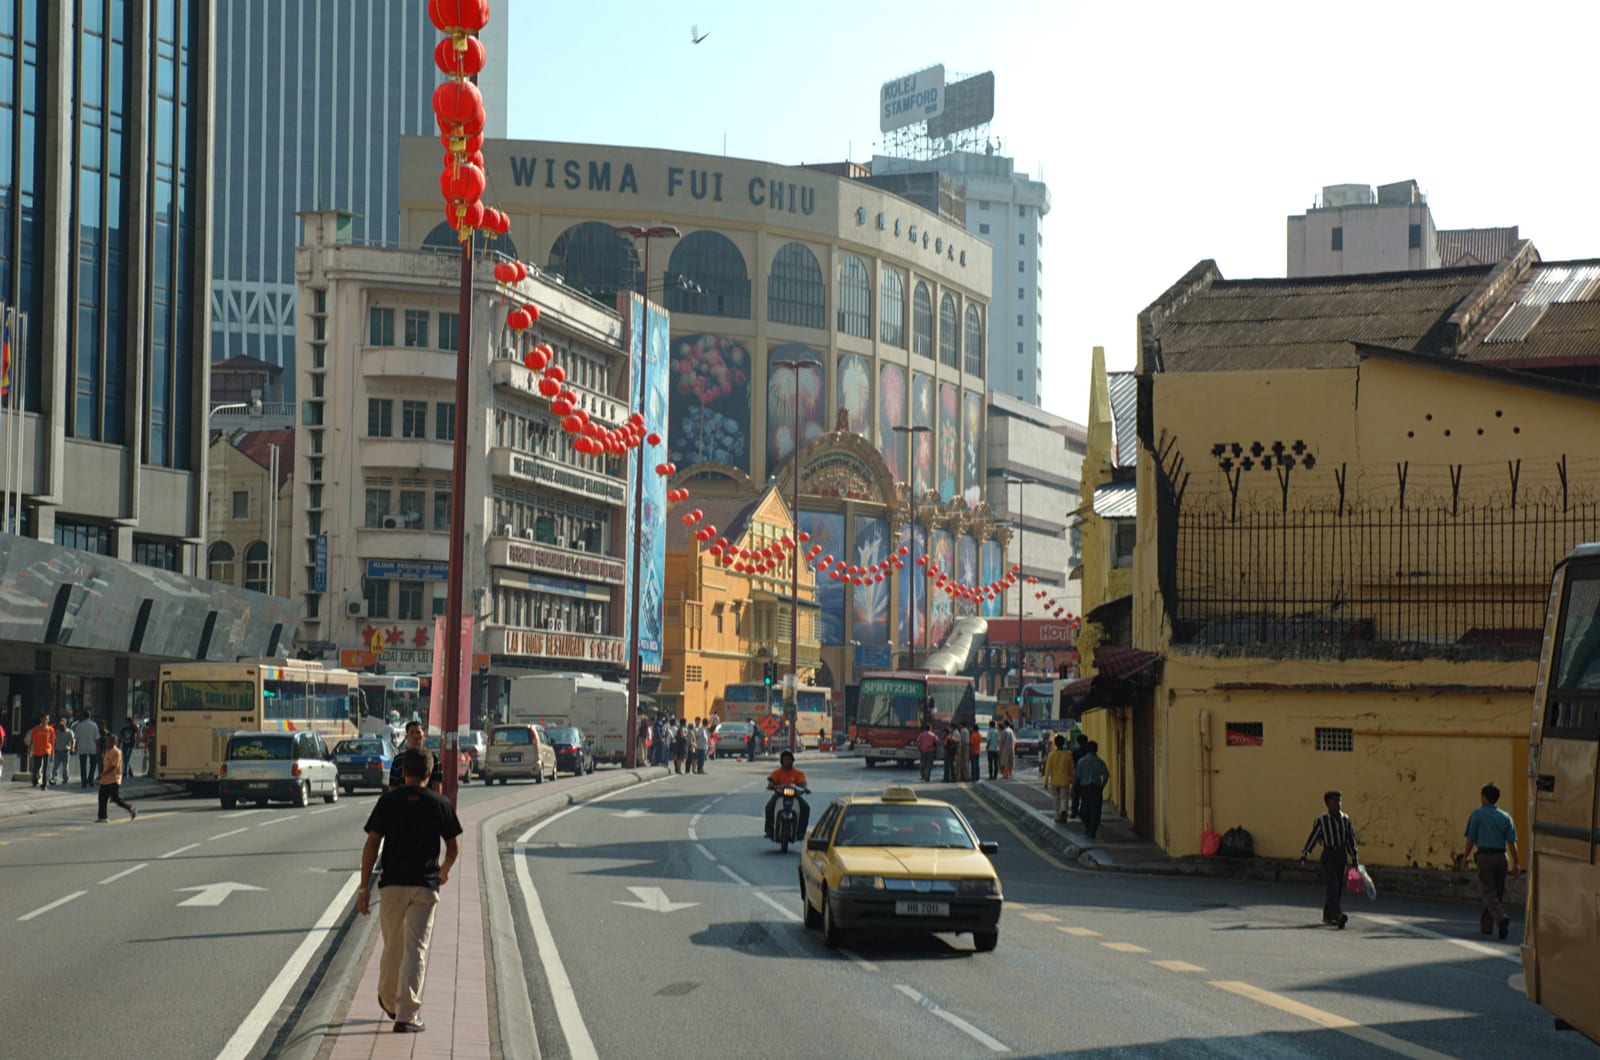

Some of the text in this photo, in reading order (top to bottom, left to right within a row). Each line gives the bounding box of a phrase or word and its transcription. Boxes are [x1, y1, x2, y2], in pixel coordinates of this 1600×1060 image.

[884, 76, 916, 100] KOLEJ
[884, 88, 938, 118] STAMFORD
[510, 156, 815, 216] WISMA FUI CHIU
[506, 631, 519, 654] LAI
[546, 634, 585, 657] RESTAURANT
[400, 651, 415, 662] KOPI
[418, 651, 428, 663] LAI
[863, 681, 917, 693] SPRITZER
